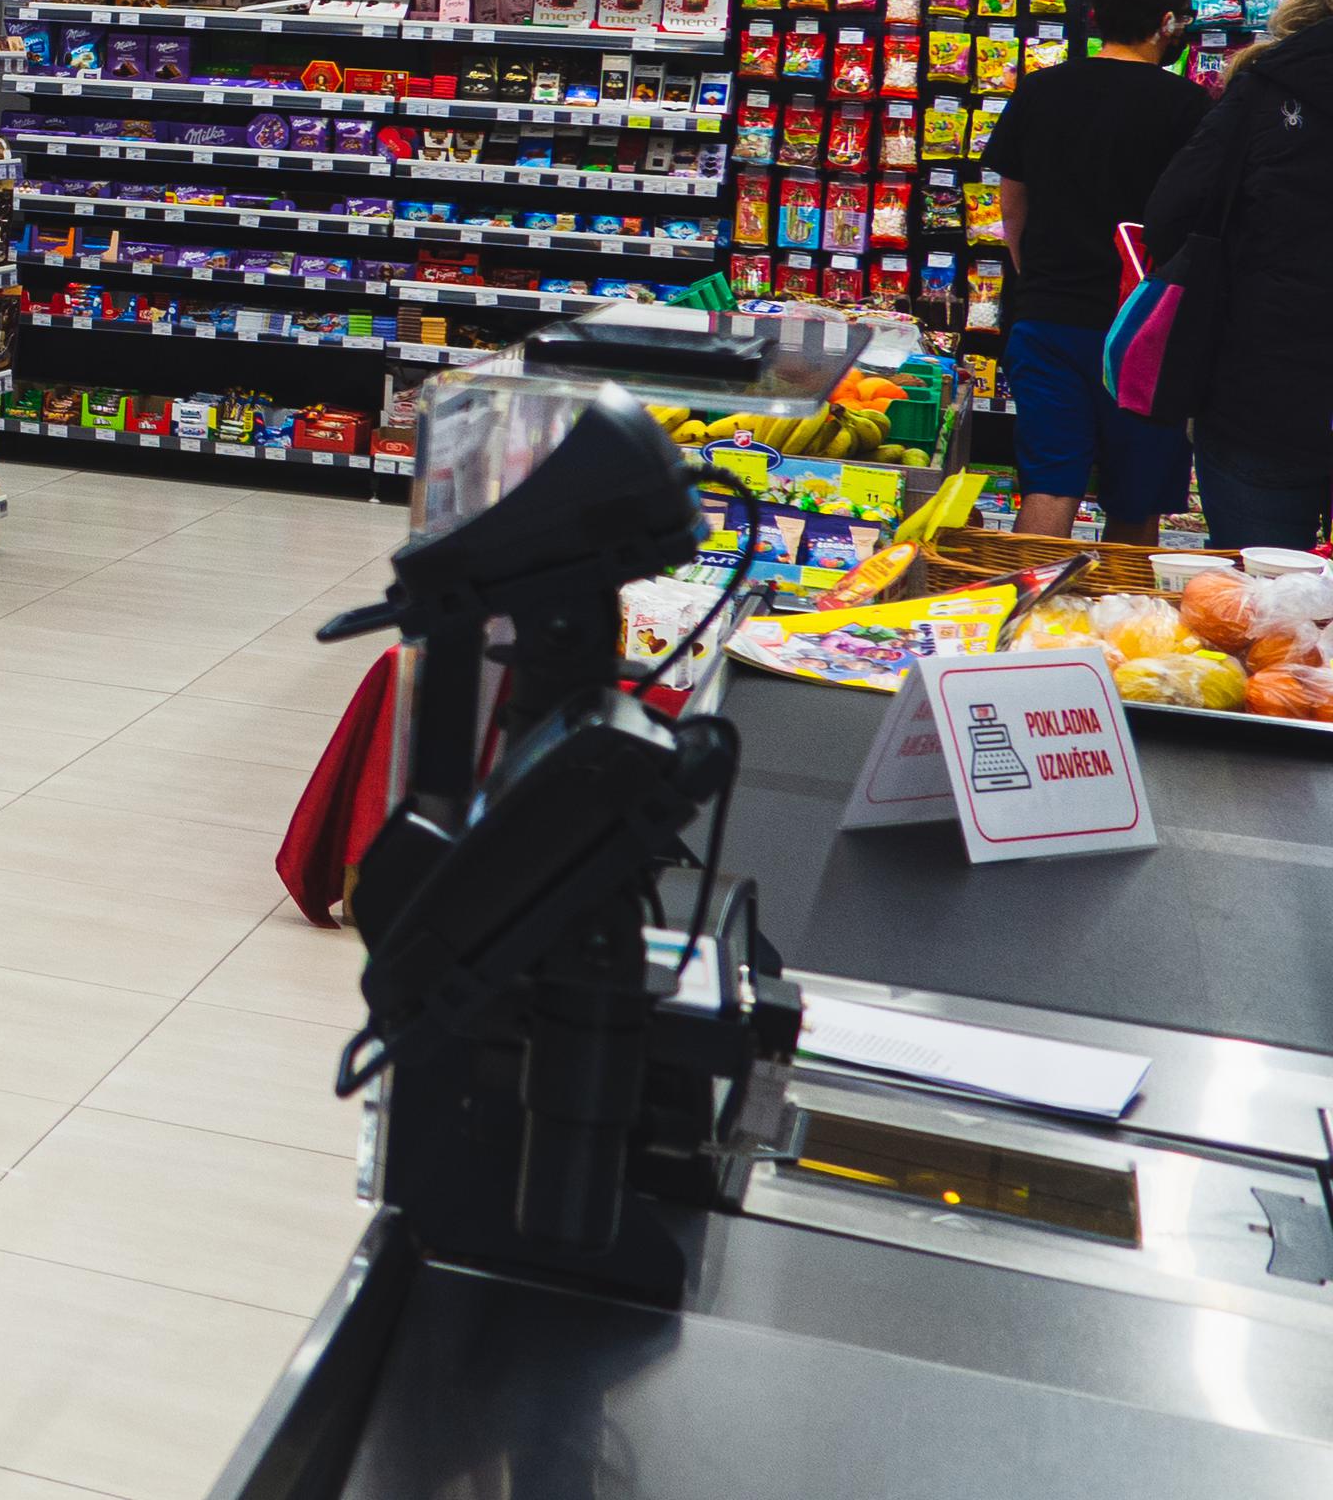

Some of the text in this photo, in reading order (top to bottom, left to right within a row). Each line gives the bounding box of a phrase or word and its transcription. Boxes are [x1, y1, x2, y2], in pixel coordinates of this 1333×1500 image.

[540, 12, 587, 23] merci
[605, 14, 653, 26] merci
[669, 16, 718, 28] merci
[184, 125, 227, 145] Milka
[1025, 707, 1102, 738] POKLADNA
[1036, 746, 1114, 781] UZAVŘENA
